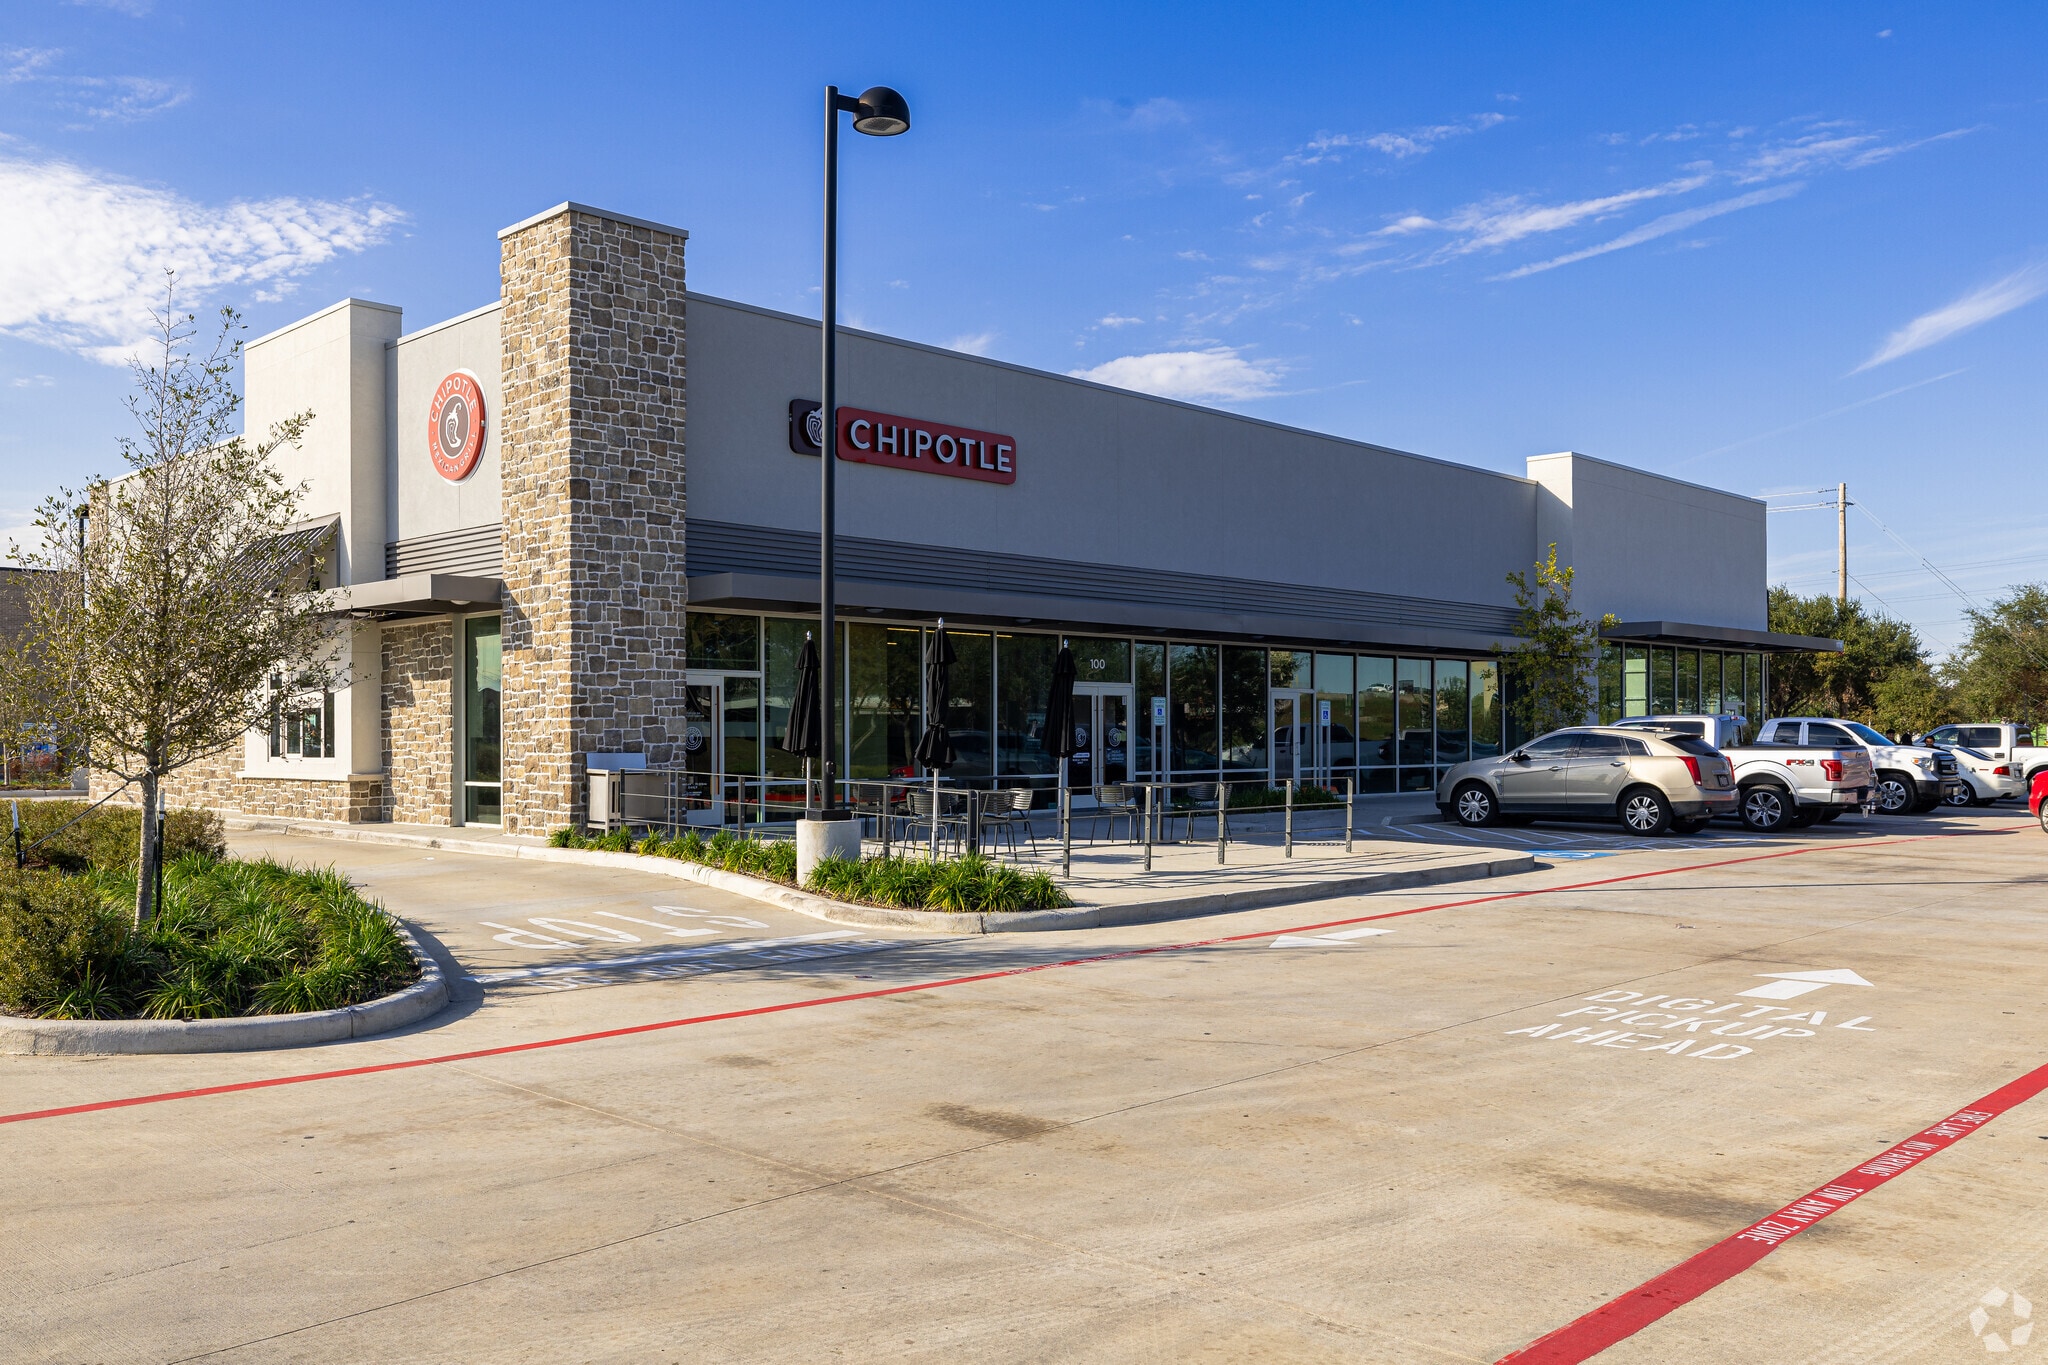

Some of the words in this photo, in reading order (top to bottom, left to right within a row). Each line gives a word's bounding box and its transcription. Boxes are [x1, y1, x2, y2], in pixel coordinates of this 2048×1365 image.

[430, 376, 477, 423] CHIPOTLE
[431, 441, 459, 473] MEXICAN
[459, 431, 477, 467] GRILL
[850, 419, 1012, 473] CHIPOTLE
[1090, 658, 1105, 669] 100
[479, 905, 770, 950] STOP
[1556, 1005, 1816, 1040] PICKUP
[1583, 990, 1877, 1032] DIGITAL
[1505, 1023, 1753, 1059] AHEAD
[1924, 1121, 1973, 1138] LANE
[1948, 1109, 1994, 1125] FIRE
[1901, 1140, 1940, 1151] NO
[1858, 1148, 1924, 1177] PARKING
[1814, 1184, 1864, 1202] TOW
[1777, 1198, 1837, 1224] AWAY
[1737, 1220, 1801, 1245] ZONE
